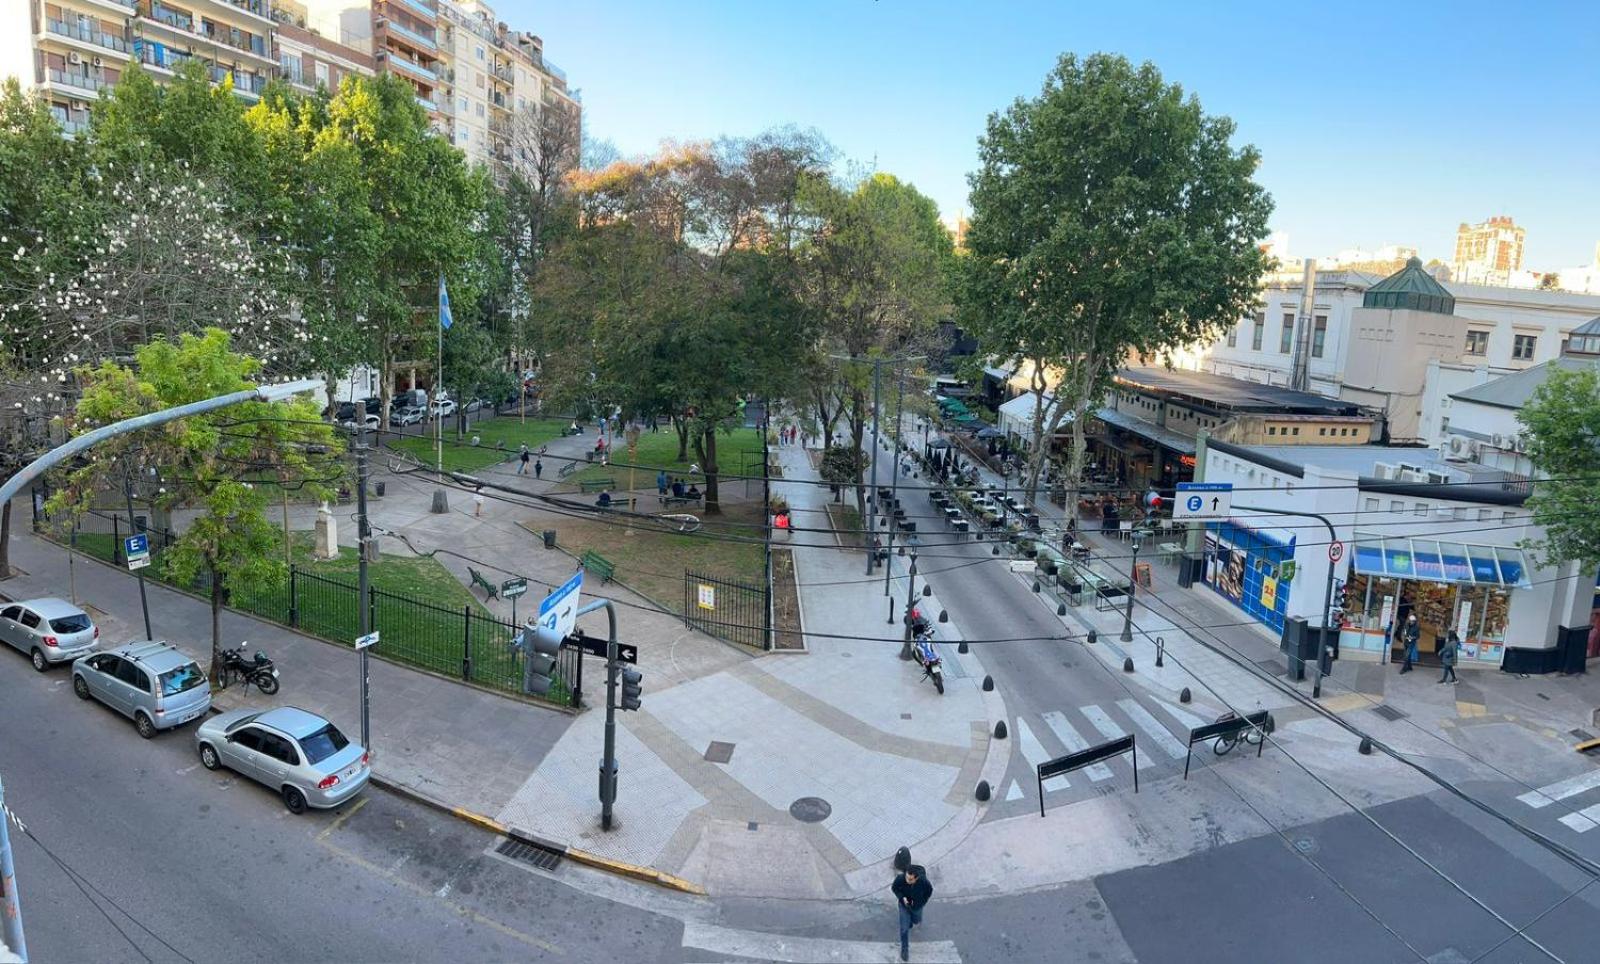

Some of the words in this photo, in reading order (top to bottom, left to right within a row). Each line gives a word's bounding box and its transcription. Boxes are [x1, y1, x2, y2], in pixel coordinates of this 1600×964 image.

[1190, 498, 1200, 510] E
[130, 539, 140, 551] E
[1331, 546, 1341, 556] 20
